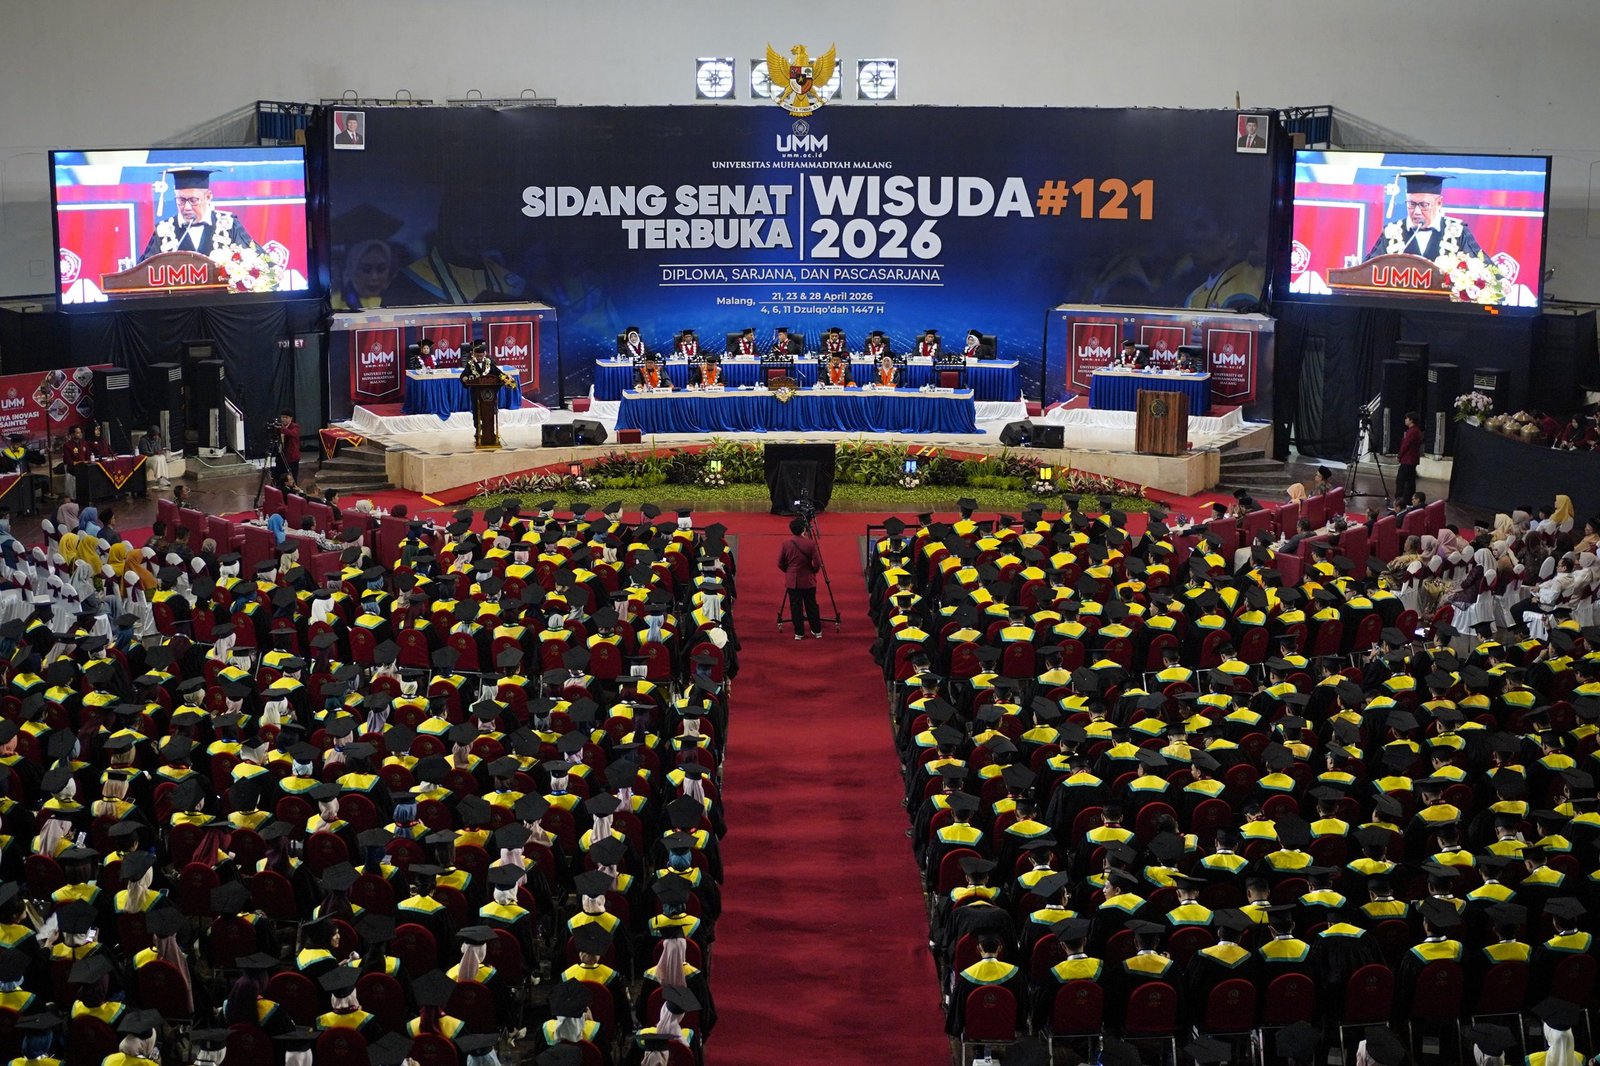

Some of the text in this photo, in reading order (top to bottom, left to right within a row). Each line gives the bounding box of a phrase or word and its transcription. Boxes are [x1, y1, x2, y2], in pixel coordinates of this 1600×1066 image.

[776, 134, 828, 152] UMM
[712, 161, 892, 169] UNIVERSITAS MUHAMMADIYAH MALANG
[521, 184, 793, 217] SIDANG SENAT
[809, 175, 1154, 220] WISUDA #121
[621, 218, 793, 249] TERBUKA
[810, 218, 942, 260] 2026
[148, 263, 209, 286] UMM
[662, 268, 940, 282] DIPLOMA, SARJANA, DAN PASCASARJANA
[1372, 264, 1433, 289] UMM
[717, 296, 756, 307] Malang,
[772, 291, 873, 302] 21, 23 & 28 April 2026
[760, 306, 770, 314] 4,
[772, 305, 782, 314] 6,
[783, 305, 791, 313] 11
[876, 306, 884, 314] H
[278, 339, 304, 348] TOIET
[361, 351, 394, 364] UMM
[495, 345, 528, 358] UMM
[1078, 346, 1112, 359] UMM
[1212, 352, 1246, 366] UMM
[1, 397, 25, 409] UMM
[12, 411, 40, 420] INOVASI
